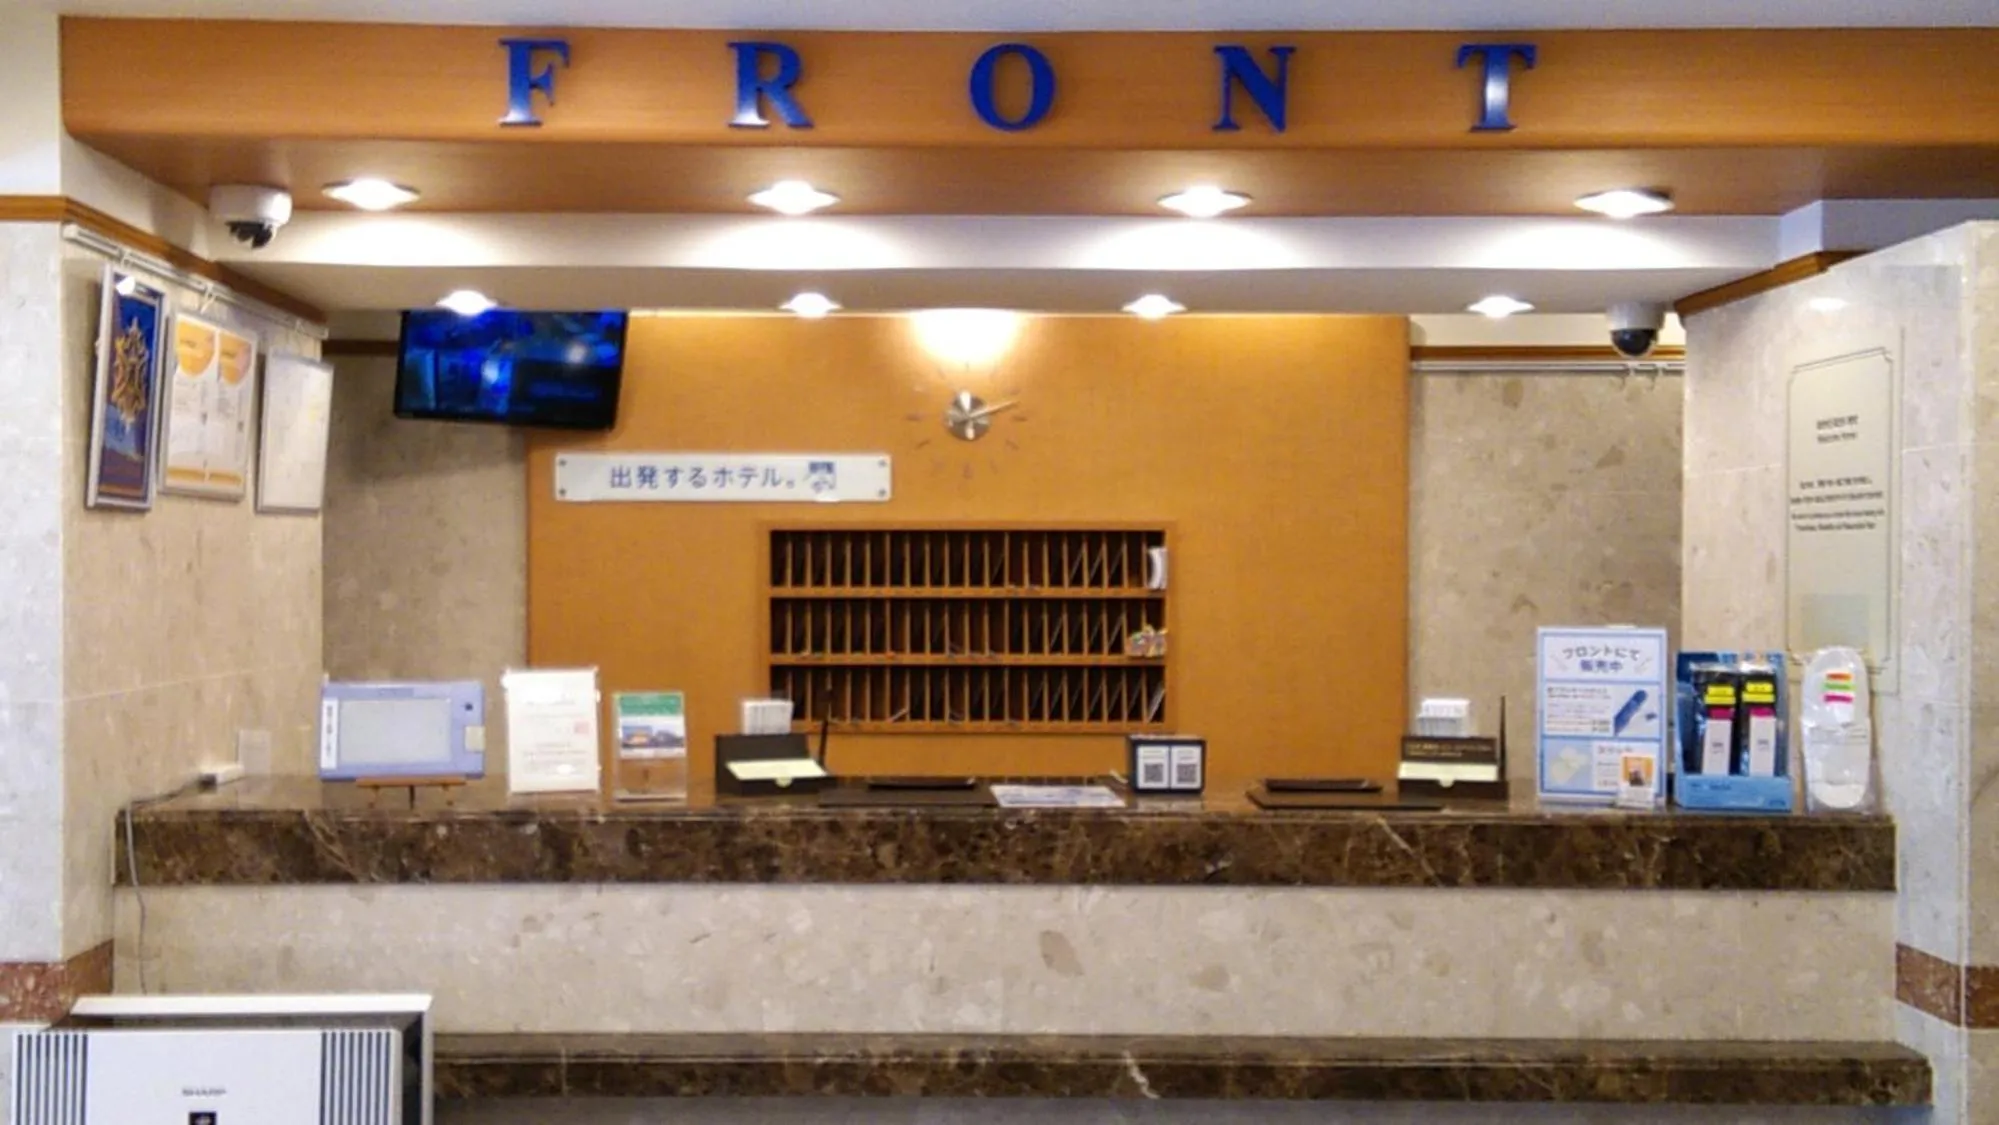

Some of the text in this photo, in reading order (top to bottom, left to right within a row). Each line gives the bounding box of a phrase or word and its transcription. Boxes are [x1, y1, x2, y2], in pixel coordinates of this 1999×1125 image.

[498, 38, 1537, 131] FRONT
[609, 464, 796, 489] 出発するホテル。
[1562, 643, 1642, 662] フロントにて
